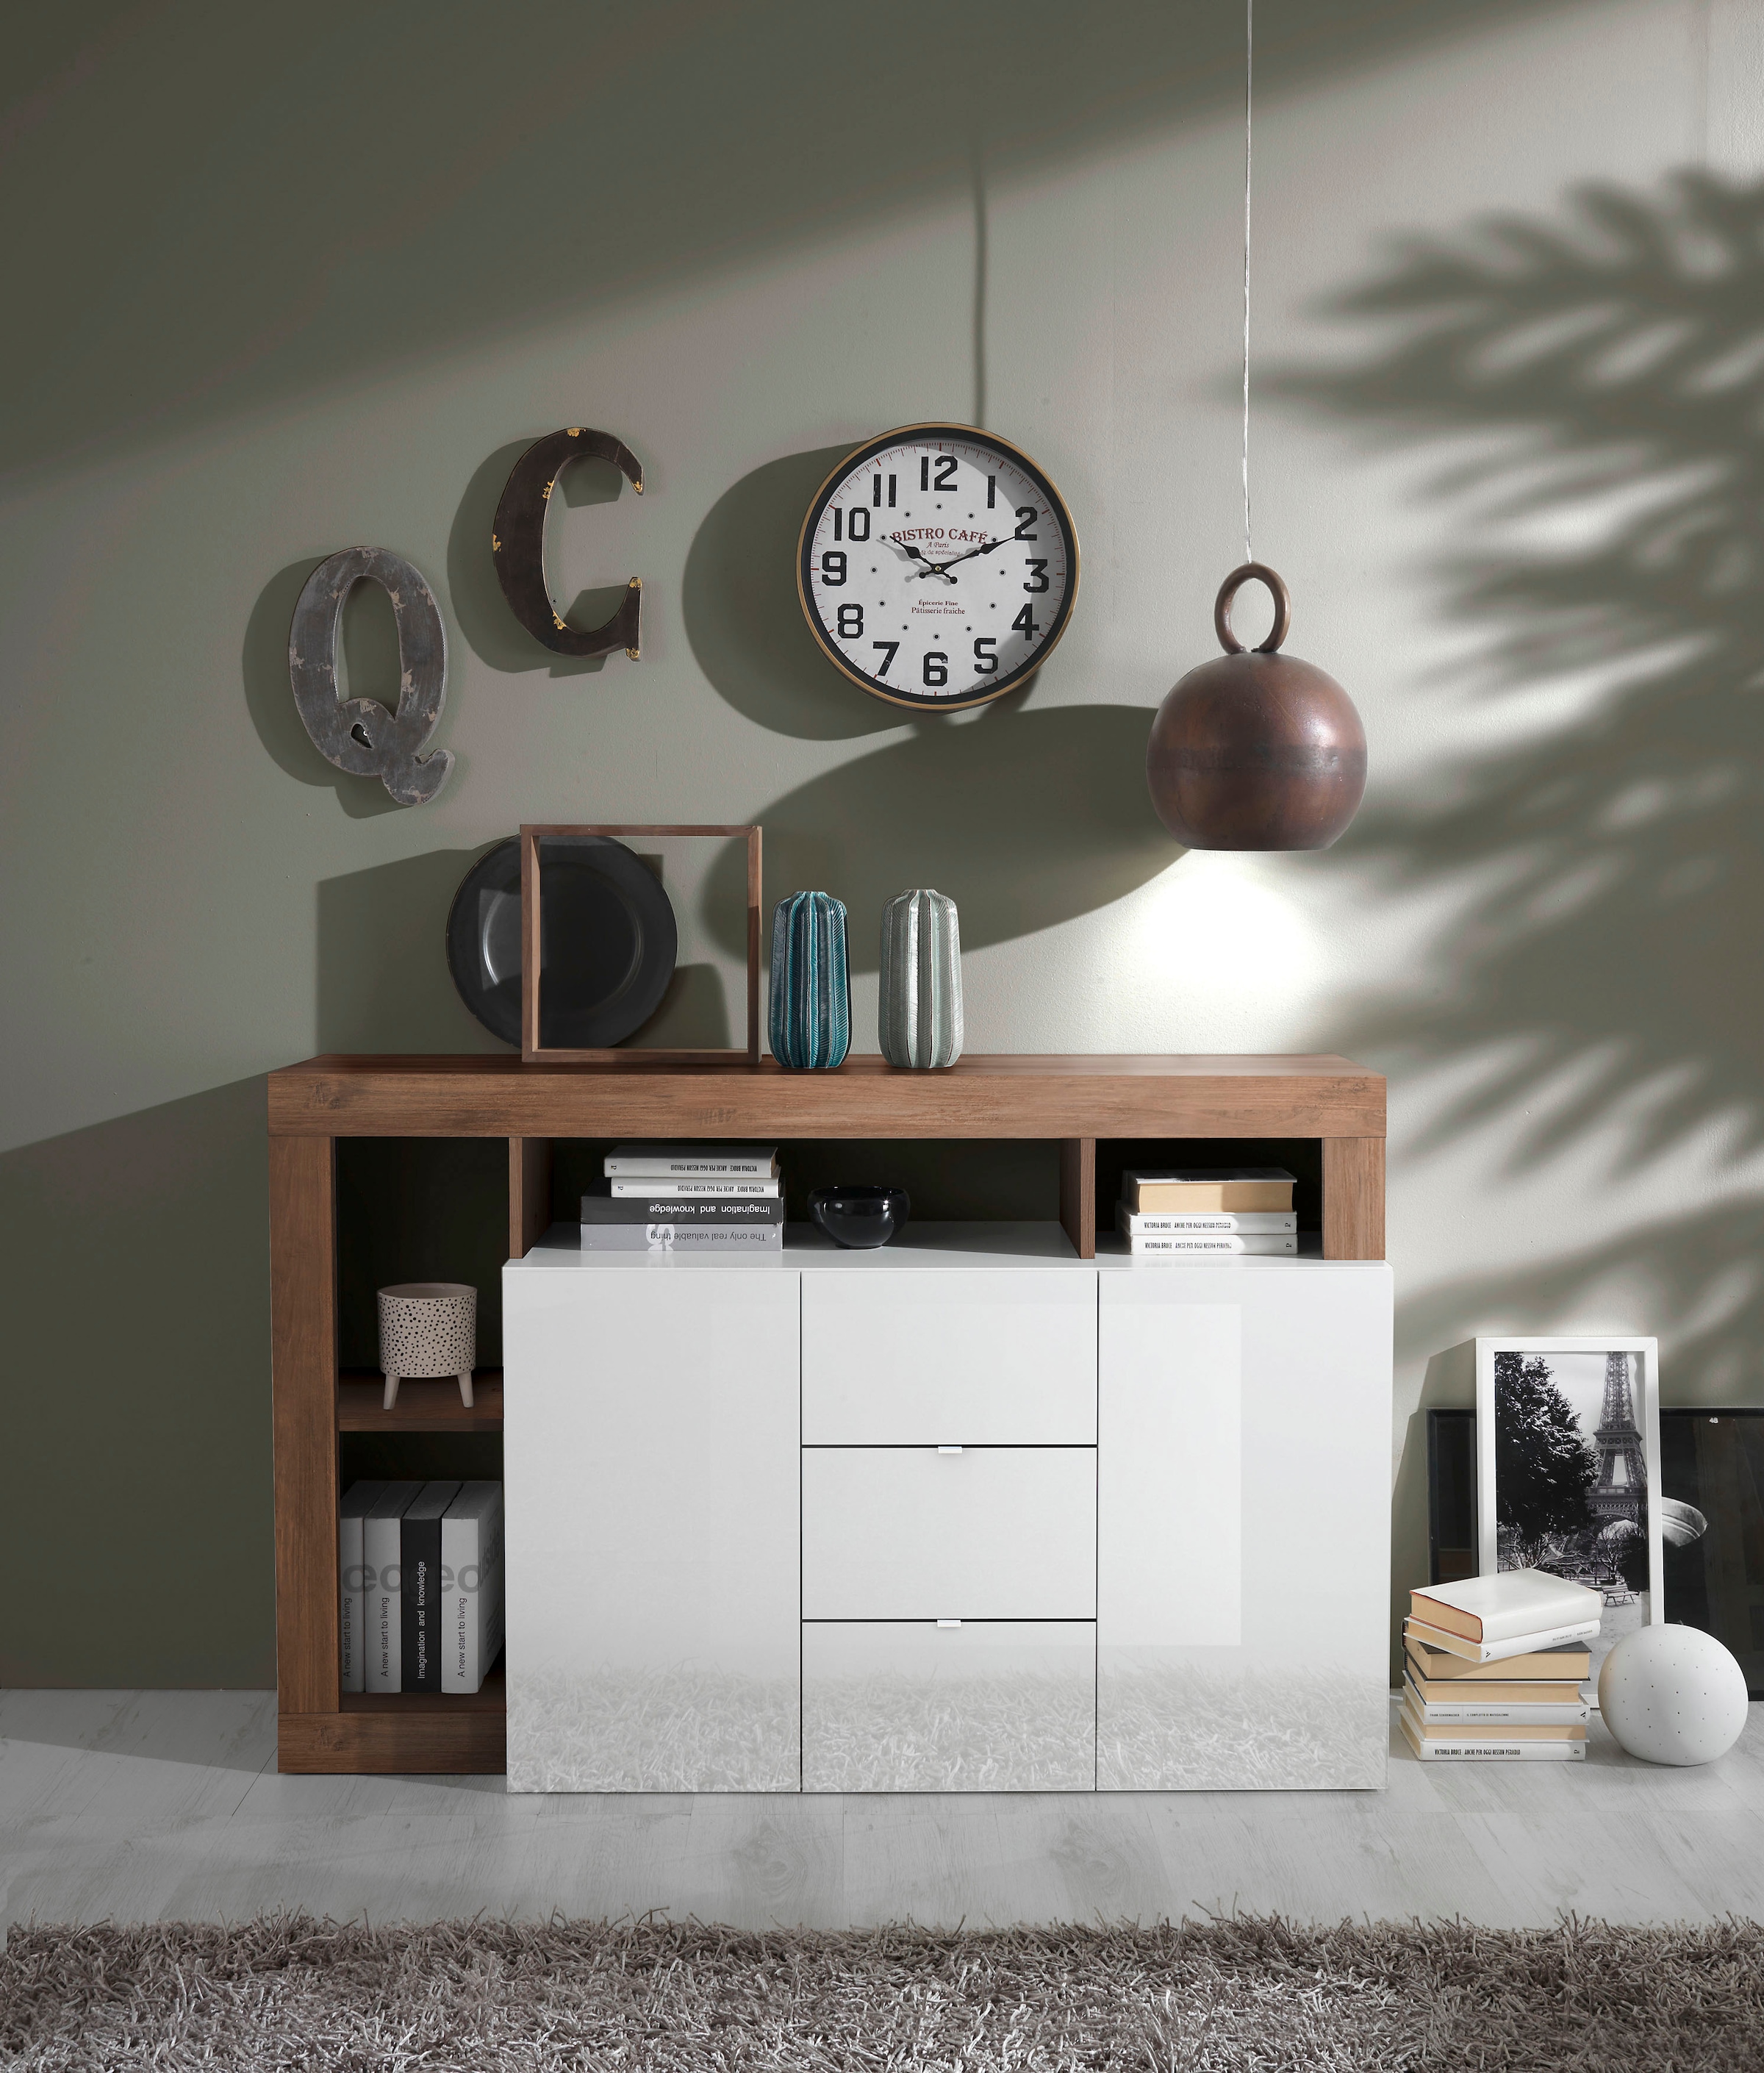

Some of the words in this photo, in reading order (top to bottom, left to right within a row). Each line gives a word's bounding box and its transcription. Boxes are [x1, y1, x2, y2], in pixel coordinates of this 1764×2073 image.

[920, 455, 958, 491] 12
[873, 473, 896, 507] 11
[987, 475, 996, 509] 1
[833, 506, 870, 542] 10
[1014, 506, 1038, 541] 2
[892, 528, 945, 543] BISTRO
[948, 529, 988, 544] CAFÉ
[821, 551, 847, 586] 9
[1022, 559, 1050, 592] 3
[919, 599, 944, 607] Épicerie
[837, 603, 864, 639] 8
[1011, 603, 1039, 641] 4
[872, 641, 900, 676] 7
[973, 637, 999, 674] 5
[289, 545, 455, 806] Q
[922, 651, 948, 687] 6
[649, 1204, 695, 1214] knowledge
[700, 1206, 717, 1214] and
[721, 1205, 770, 1214] Imagination
[650, 1231, 671, 1240] thing
[674, 1233, 709, 1241] valuable
[711, 1233, 728, 1241] real
[730, 1231, 747, 1240] only
[750, 1234, 767, 1242] The
[417, 1561, 428, 1606] knowledge
[343, 1598, 352, 1619] living
[380, 1597, 390, 1619] living
[457, 1598, 467, 1619] living
[343, 1621, 351, 1629] to
[381, 1621, 388, 1629] to
[458, 1621, 465, 1629] to
[417, 1630, 428, 1679] Imagination
